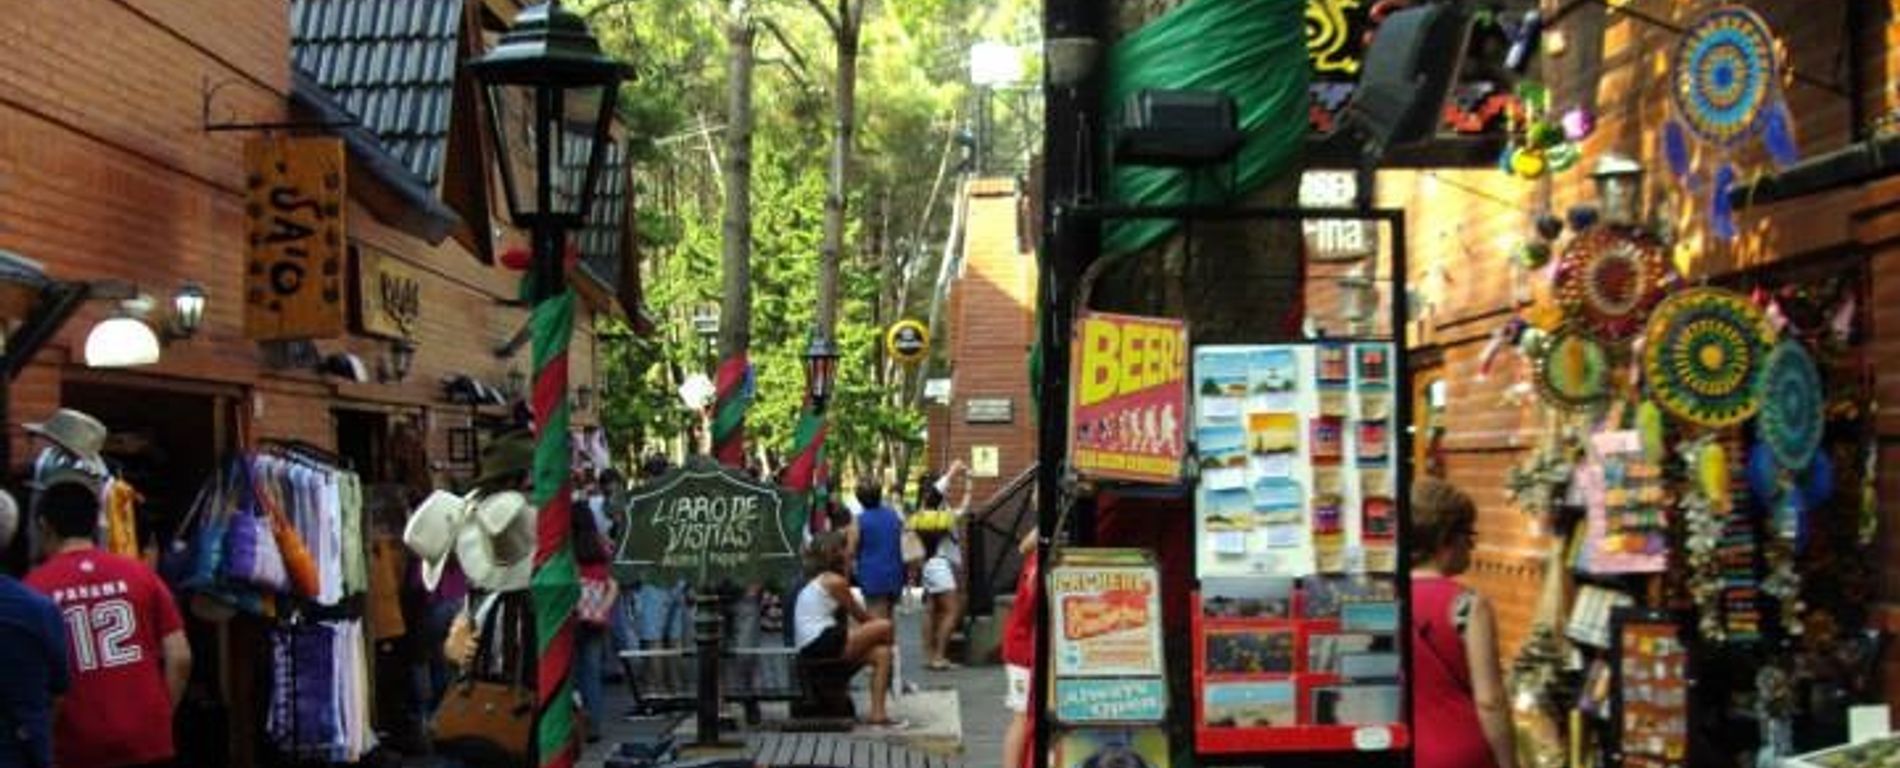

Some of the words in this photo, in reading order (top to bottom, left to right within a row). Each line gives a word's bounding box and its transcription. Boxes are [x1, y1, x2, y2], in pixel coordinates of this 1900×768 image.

[652, 496, 727, 523] LIBRO
[731, 495, 759, 521] DE
[664, 524, 752, 552] VISITAS
[54, 580, 128, 603] PANAMA
[63, 599, 142, 672] 12
